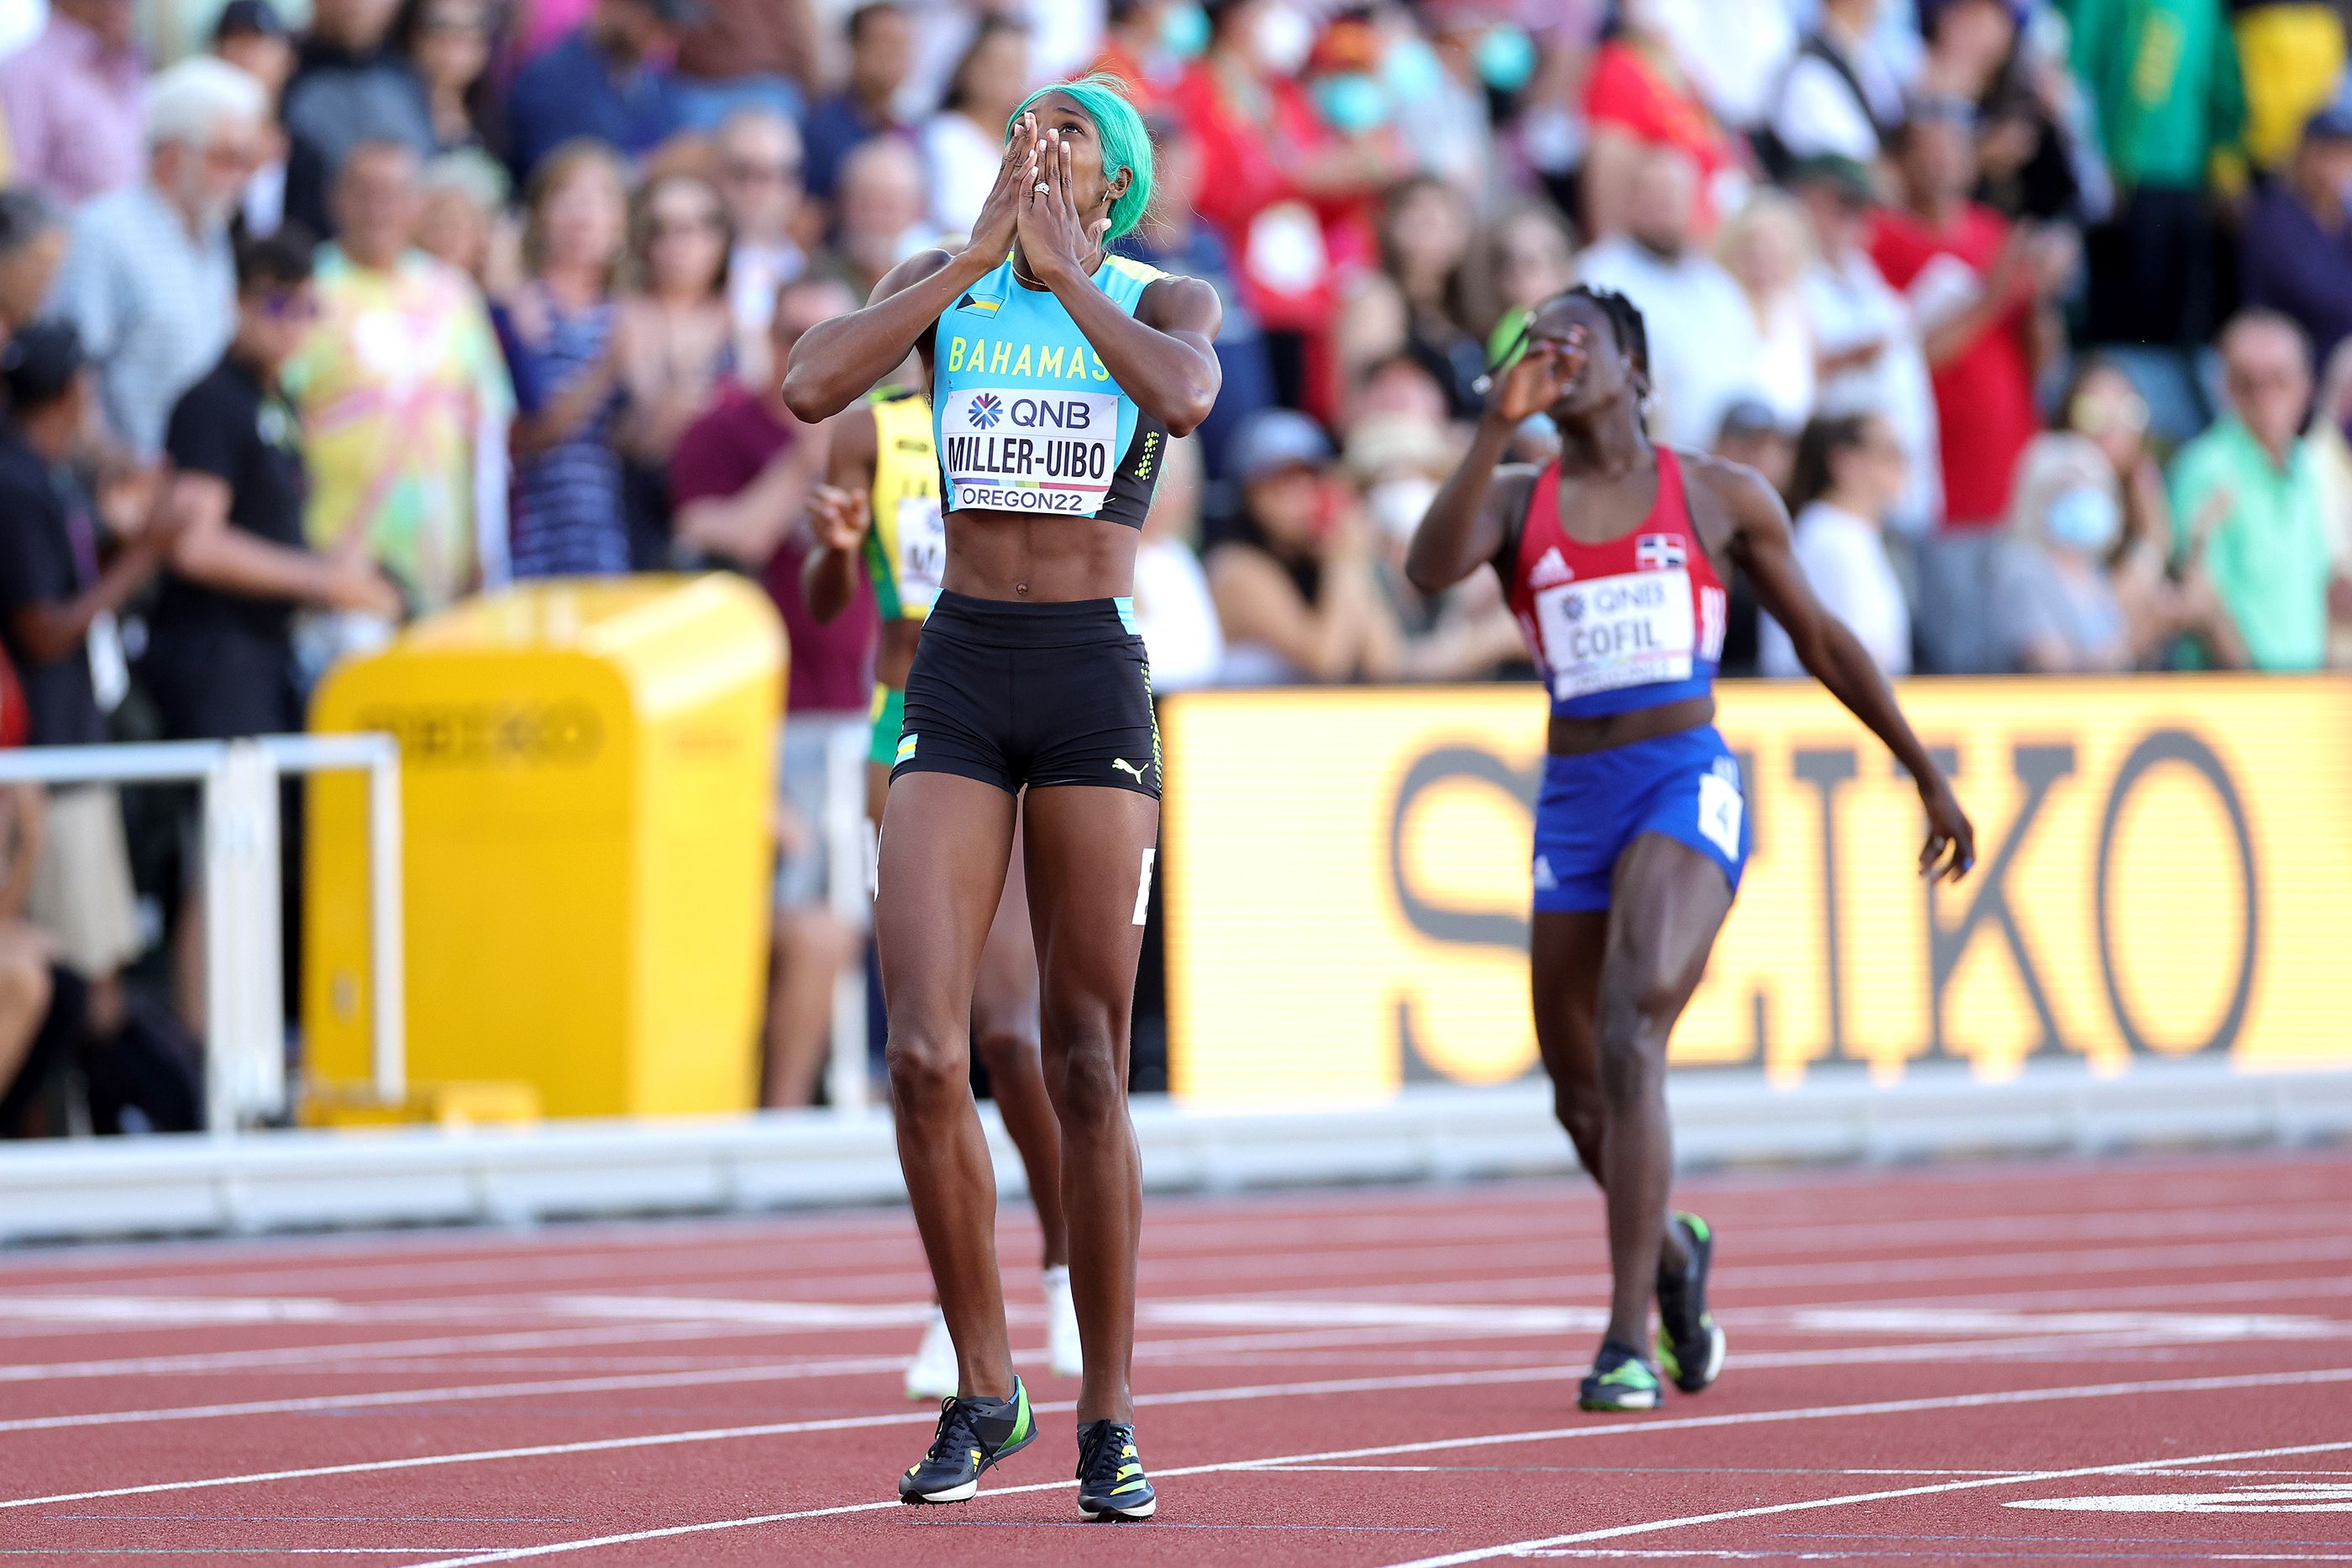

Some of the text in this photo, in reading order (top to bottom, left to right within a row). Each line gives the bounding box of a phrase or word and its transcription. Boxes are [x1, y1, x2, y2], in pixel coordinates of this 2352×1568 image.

[948, 336, 1110, 381] BAHAMAS
[1011, 398, 1090, 429] QNB
[948, 436, 1105, 480] MILLER-UIBO
[963, 487, 1082, 511] OREGON22
[1594, 579, 1666, 613] QNB
[1569, 617, 1654, 661] COFIL
